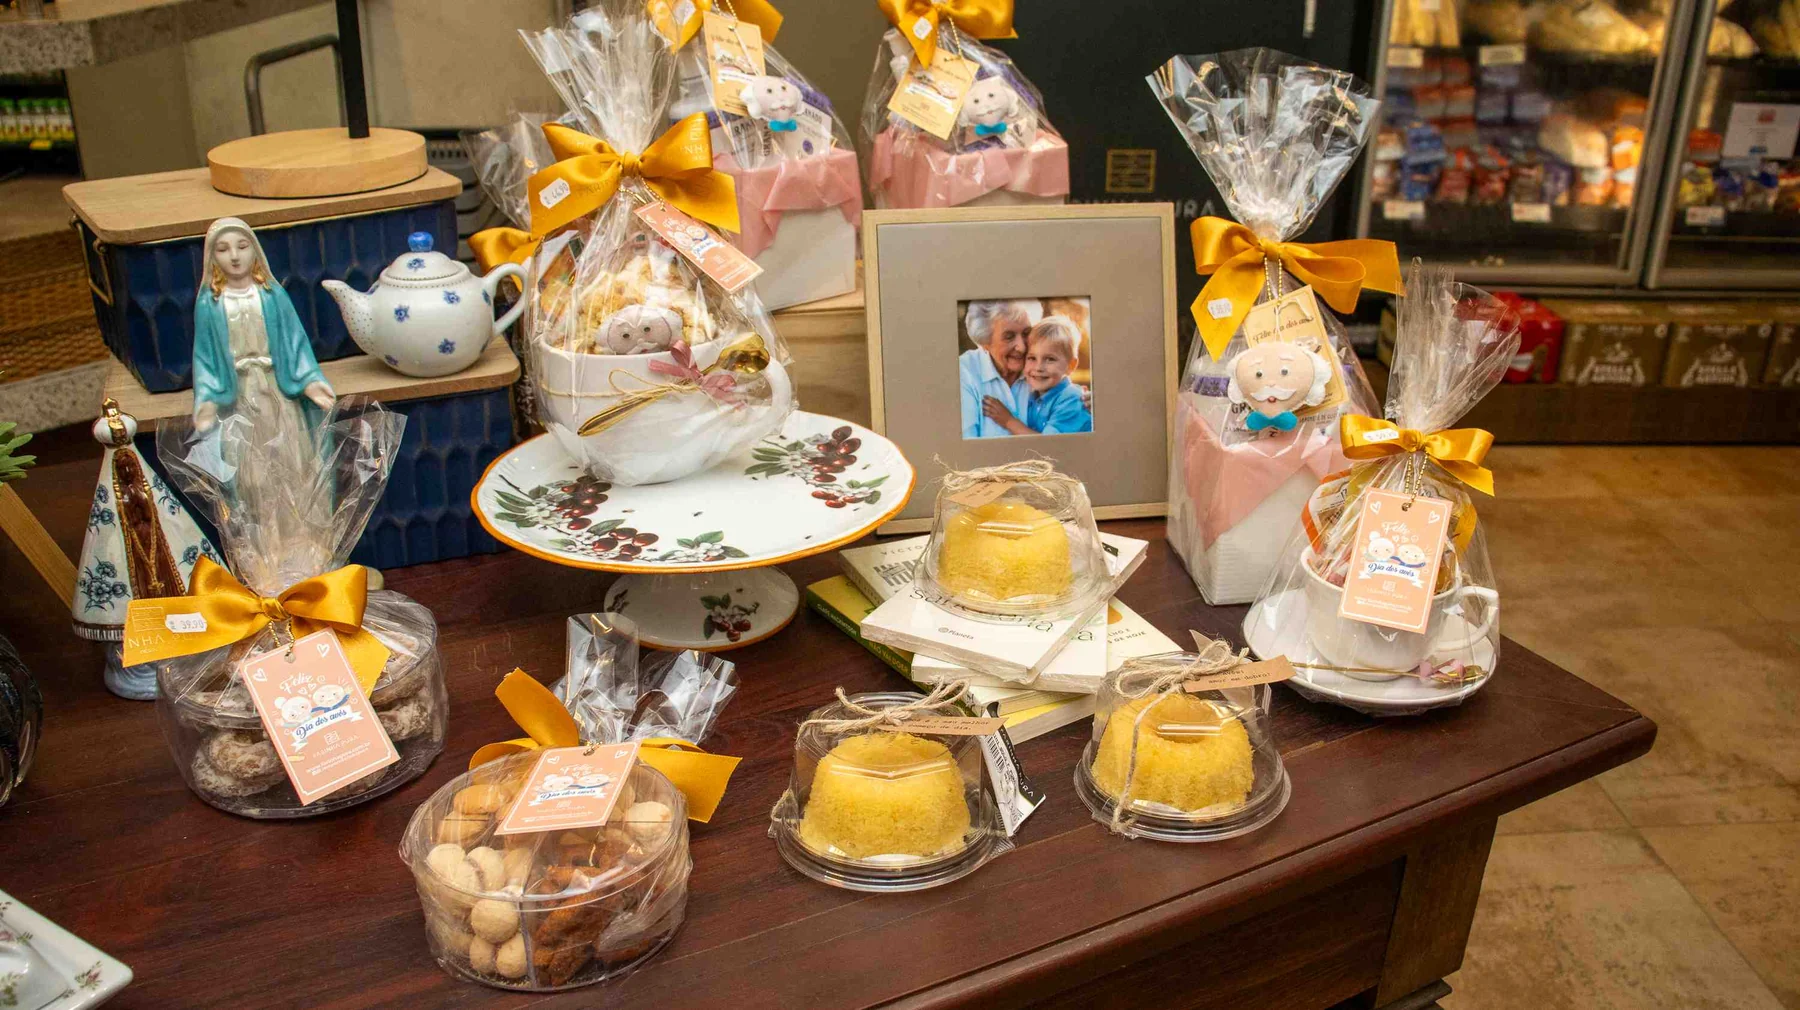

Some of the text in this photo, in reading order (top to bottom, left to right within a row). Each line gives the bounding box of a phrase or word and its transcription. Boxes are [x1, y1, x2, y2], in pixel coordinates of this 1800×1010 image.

[880, 545, 924, 556] VICTO
[1368, 562, 1385, 573] Dia
[1385, 563, 1399, 574] dos
[948, 629, 975, 641] Planeta
[279, 672, 314, 695] Feliz
[295, 722, 314, 740] Dia
[314, 715, 329, 728] dos
